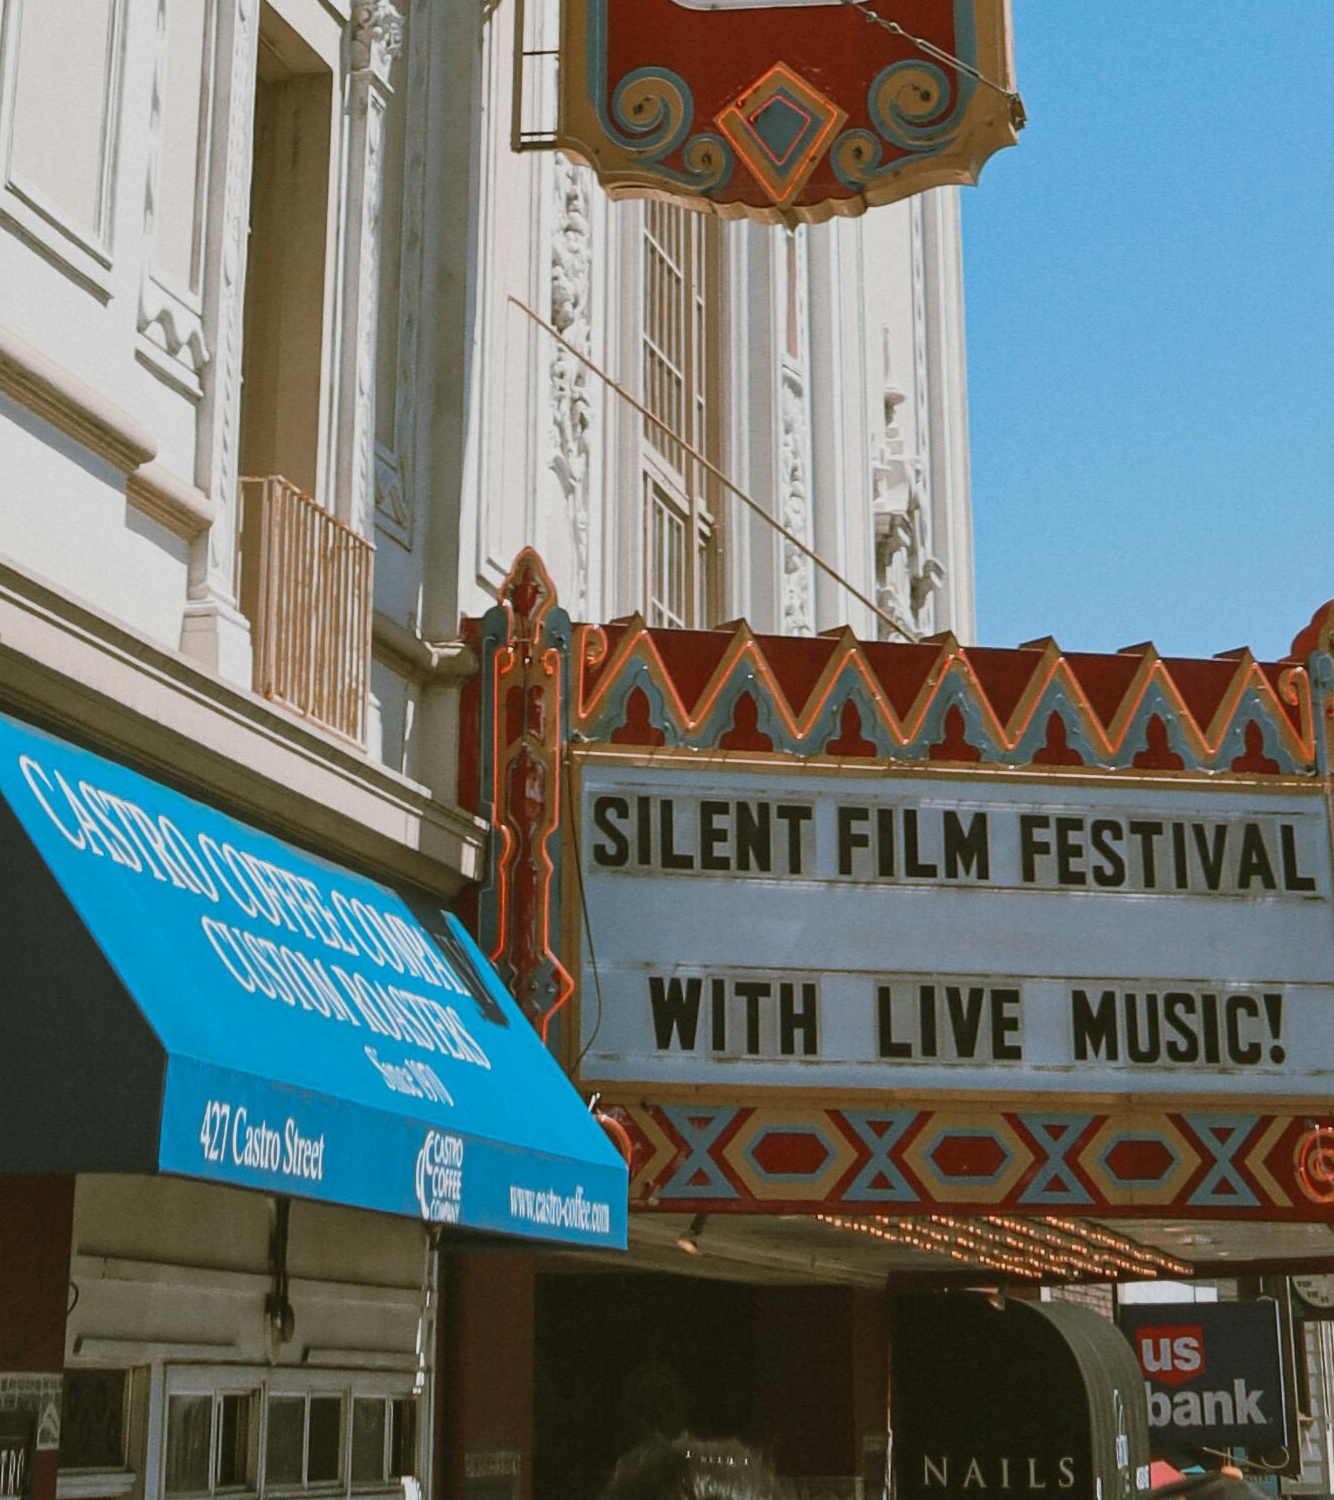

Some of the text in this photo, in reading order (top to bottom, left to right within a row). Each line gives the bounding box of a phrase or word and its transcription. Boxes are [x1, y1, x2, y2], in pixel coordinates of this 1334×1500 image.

[19, 755, 219, 902] CASTRO
[198, 833, 360, 956] COFFEE
[593, 795, 1317, 892] SILENT FILM FESTIVAL
[201, 915, 491, 1070] CUSTOM ROASTERS
[648, 976, 1286, 1066] WITH LIVE MUSIC!
[200, 1099, 325, 1180] 427 Castro Street
[434, 1133, 464, 1168] CASTRO
[432, 1165, 462, 1200] COFFEE
[510, 1184, 610, 1233] www.castro-coffee.com
[1141, 1336, 1203, 1373] us
[1145, 1378, 1268, 1429] bank
[923, 1454, 1076, 1490] NAILS
